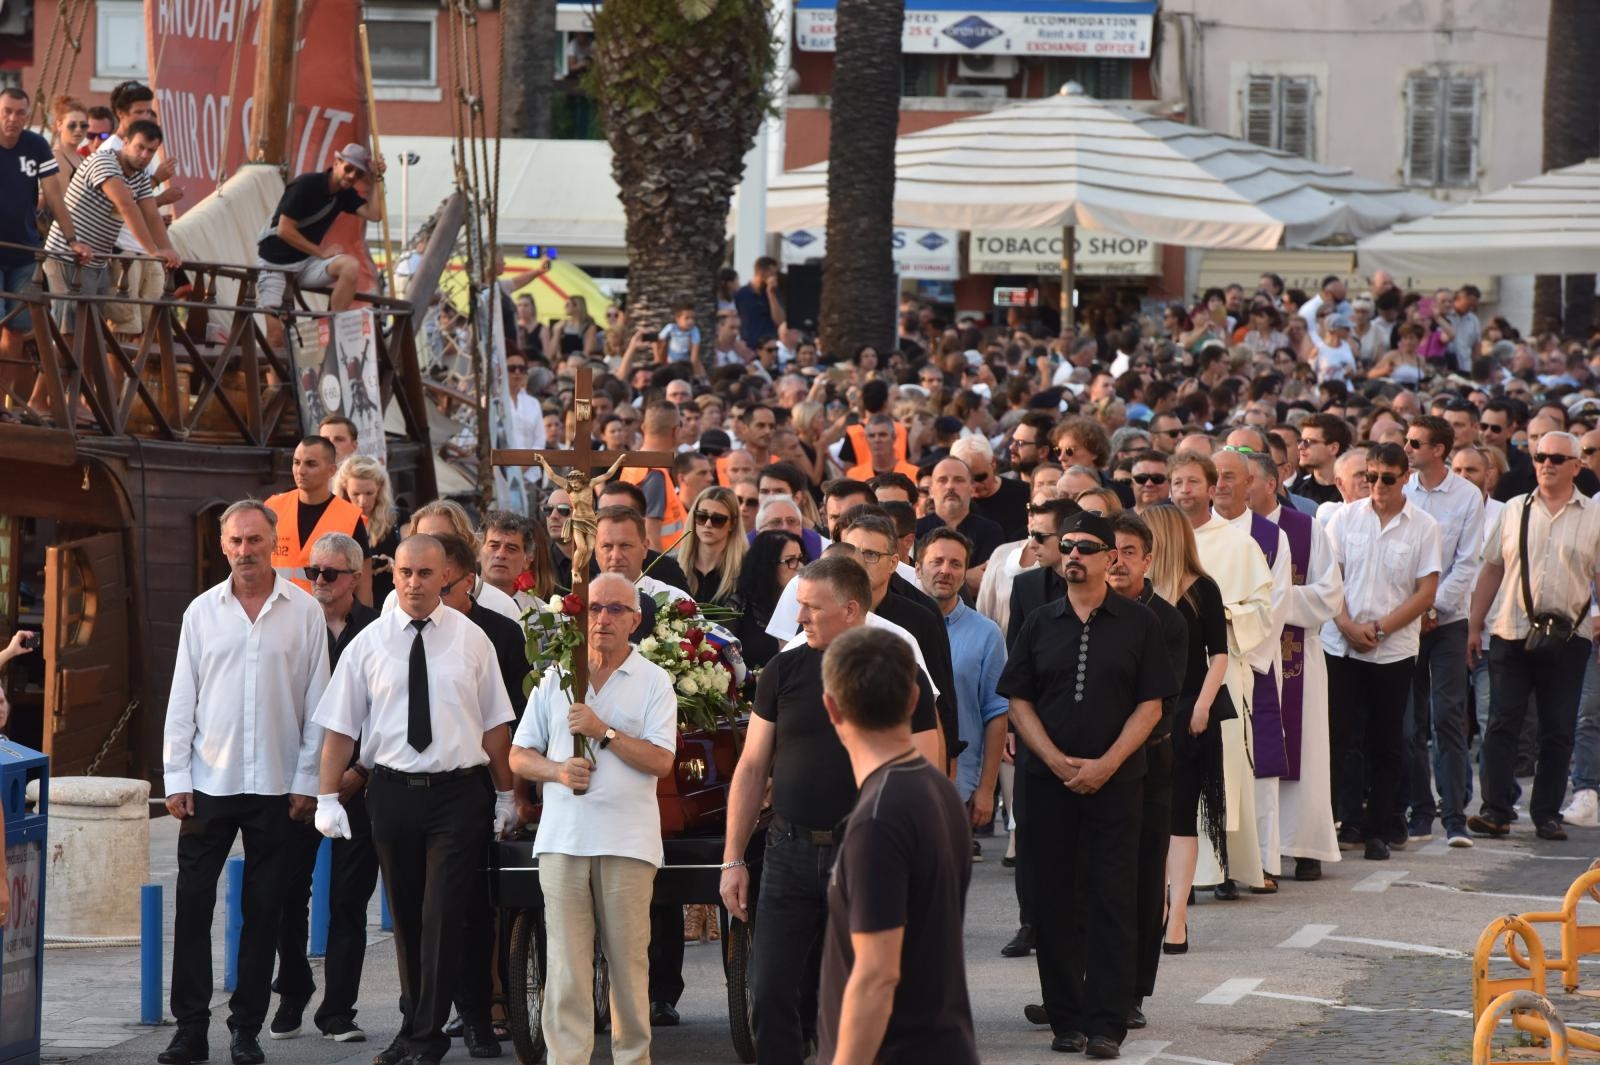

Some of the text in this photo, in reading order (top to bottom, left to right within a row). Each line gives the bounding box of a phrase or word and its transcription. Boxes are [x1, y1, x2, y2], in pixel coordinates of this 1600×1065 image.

[1023, 15, 1137, 27] ACCOMMODATION
[1038, 29, 1064, 38] Rent
[1078, 29, 1104, 39] BIKE
[1113, 30, 1126, 40] 20
[1026, 42, 1136, 53] EXCHANGE OFFICE
[157, 88, 206, 180] TOUR
[1090, 237, 1149, 255] SHOP
